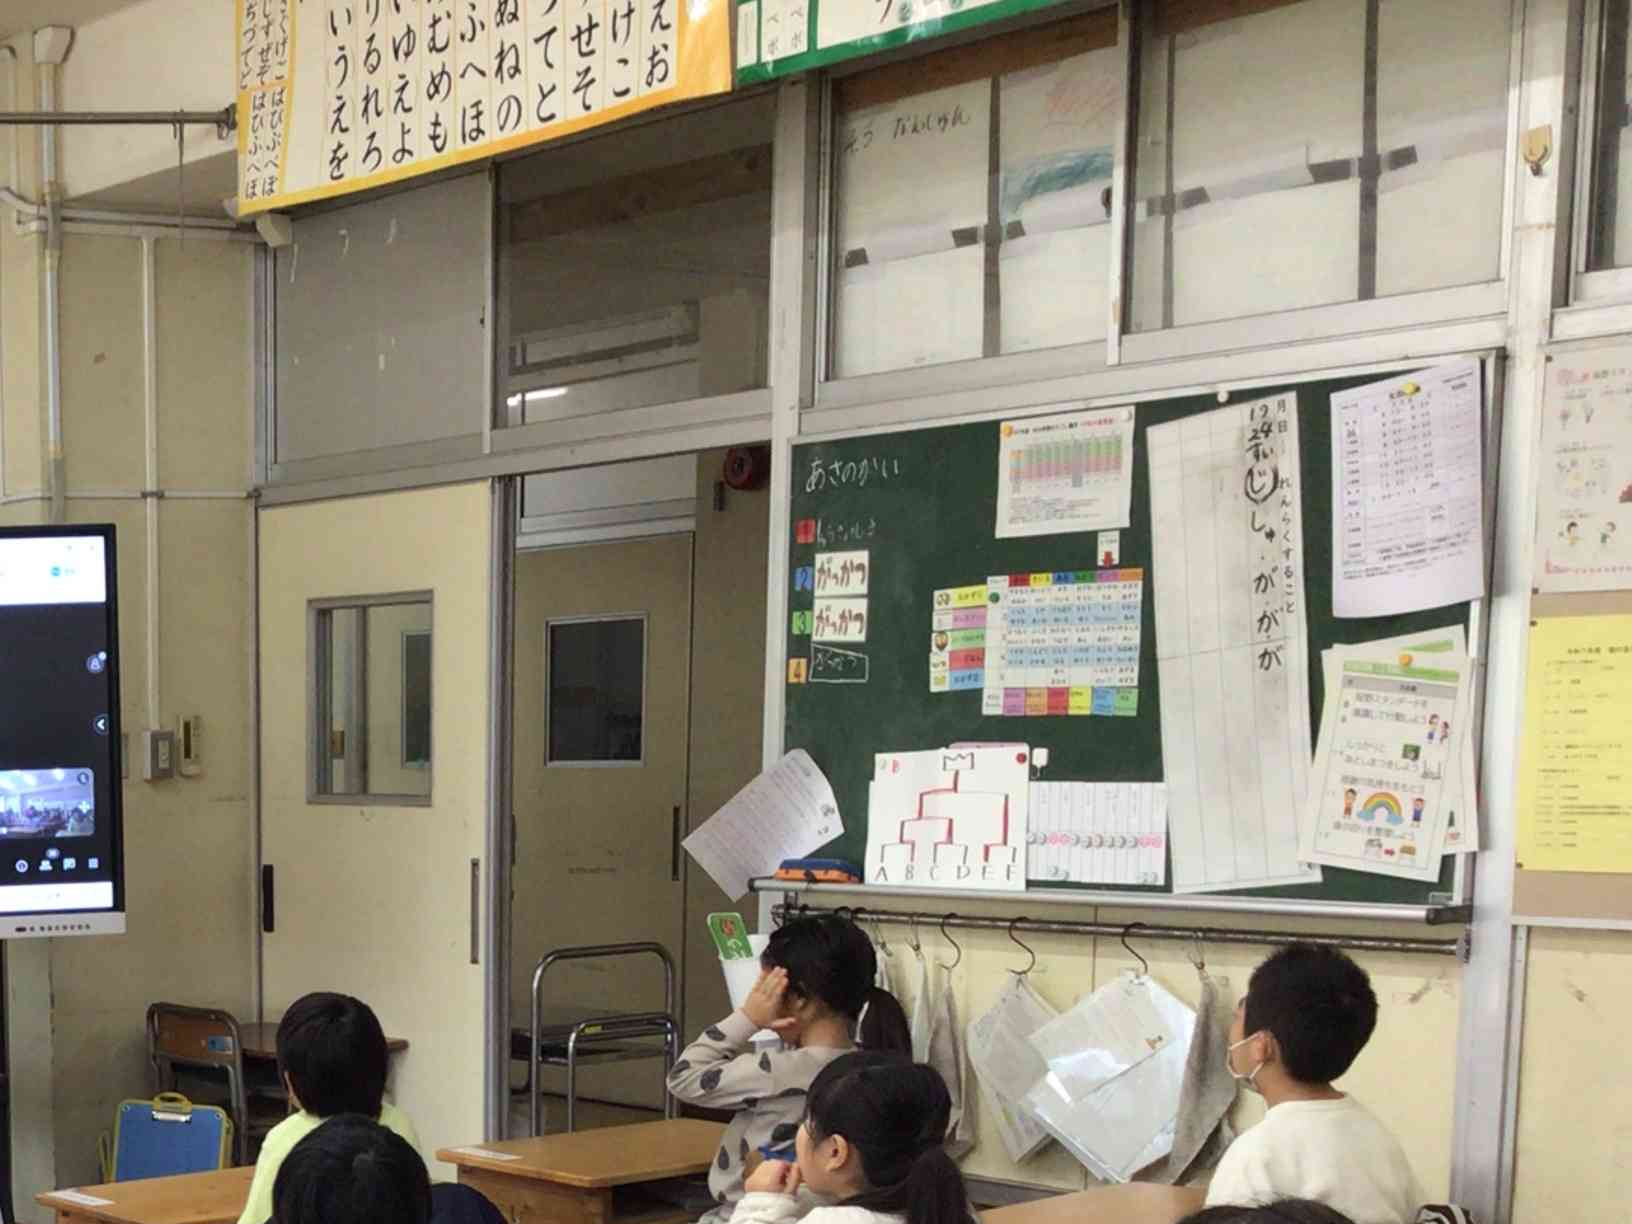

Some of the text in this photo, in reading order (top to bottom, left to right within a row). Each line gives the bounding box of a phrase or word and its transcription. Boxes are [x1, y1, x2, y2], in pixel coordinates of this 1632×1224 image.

[329, 8, 352, 180] いうえを
[459, 4, 487, 144] ふへほ
[534, 0, 557, 123] てと
[571, 0, 599, 111] せそ
[612, 0, 635, 97] けこ
[806, 457, 900, 492] あさのかい
[816, 557, 866, 590] がっかつ
[1279, 477, 1295, 613] れんらくすること
[814, 606, 864, 637] がっかつ
[875, 864, 1017, 881] A B C D E F
